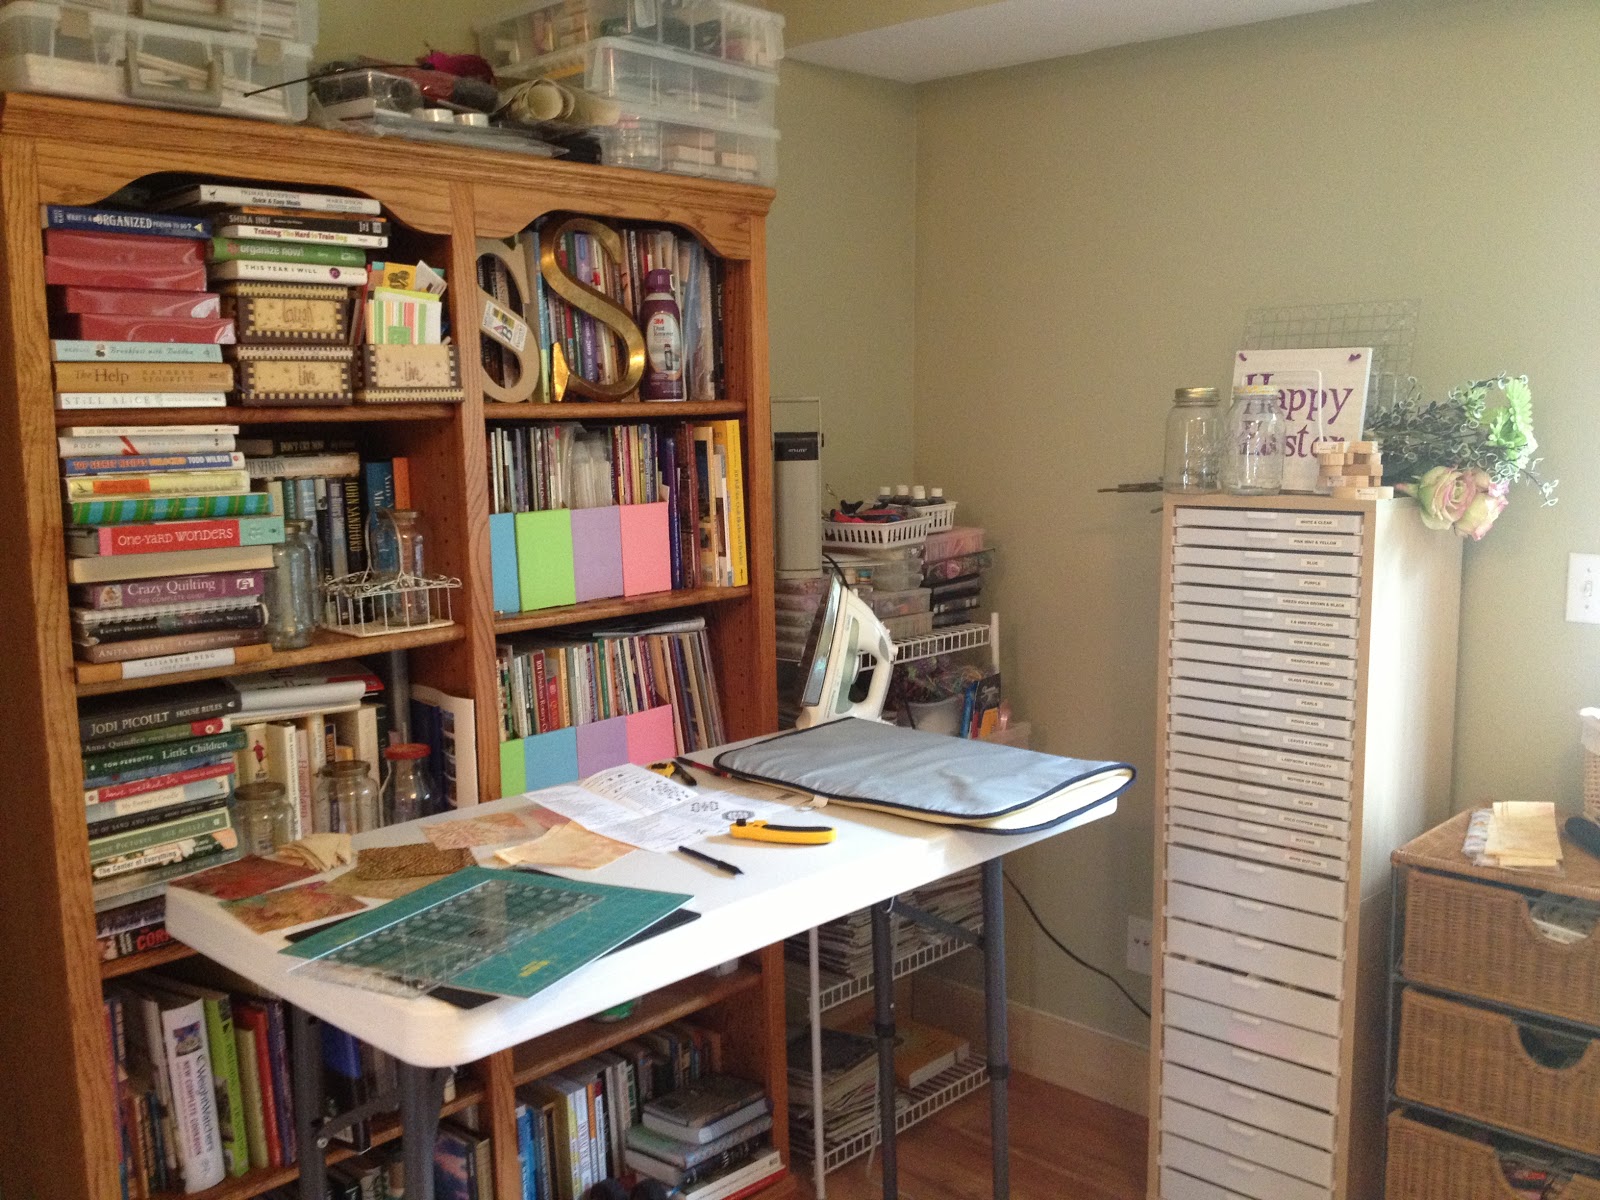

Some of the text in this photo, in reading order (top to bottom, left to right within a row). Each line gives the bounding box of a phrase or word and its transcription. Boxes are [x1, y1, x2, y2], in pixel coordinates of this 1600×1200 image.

[229, 215, 253, 225] SHIBA
[255, 216, 271, 225] INU
[254, 227, 282, 239] Training
[294, 230, 310, 239] Hard
[318, 232, 335, 240] Train
[240, 244, 280, 256] organize
[267, 265, 289, 273] YEAR
[74, 368, 130, 385] The Help
[187, 455, 205, 464] TODD
[206, 454, 230, 463] WILBUR
[345, 481, 363, 552] JOHN SANDFORD
[127, 578, 216, 597] Crazy Quilting
[98, 648, 129, 658] ANITA
[193, 652, 217, 661] BERG
[536, 659, 547, 722] 101 Fabulous Rotary
[90, 703, 223, 736] JODI PICOULT HOUSE RULES
[85, 743, 106, 752] Anna
[108, 737, 145, 749] Quindlen
[162, 746, 188, 760] Little
[189, 741, 228, 754] Children
[98, 866, 112, 875] The
[112, 861, 134, 871] Center
[143, 850, 178, 864] Everything
